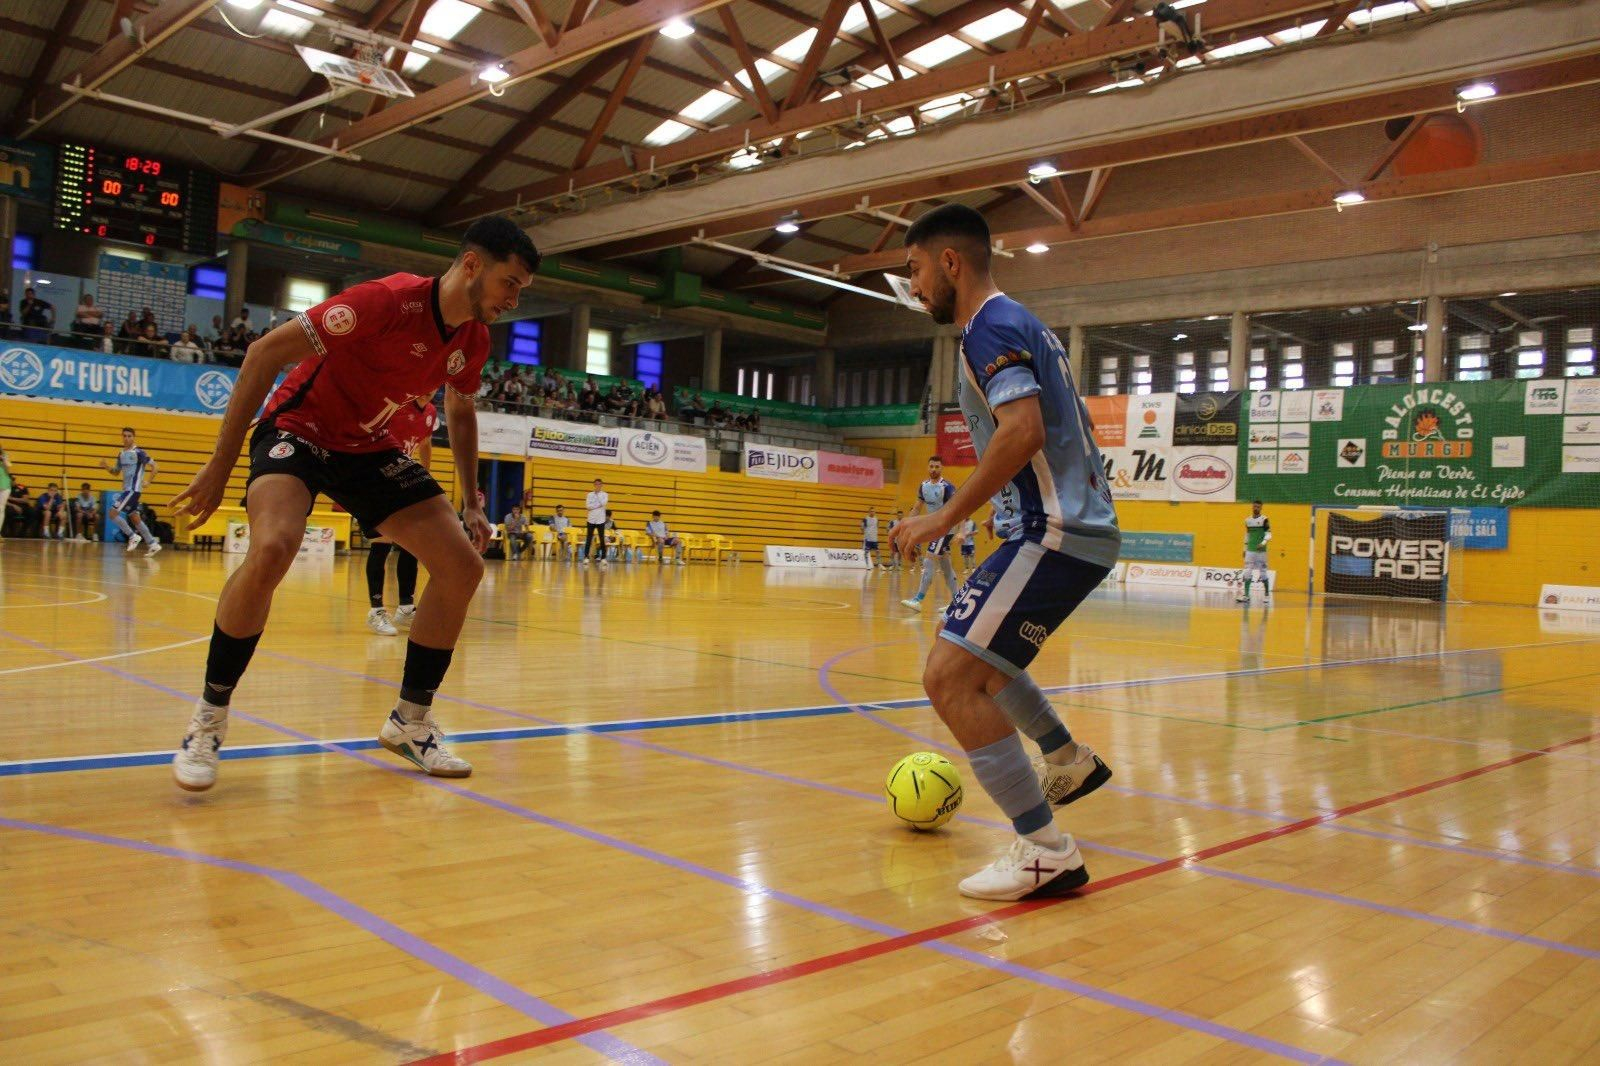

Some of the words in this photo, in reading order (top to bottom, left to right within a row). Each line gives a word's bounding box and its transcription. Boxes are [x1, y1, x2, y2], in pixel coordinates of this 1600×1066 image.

[125, 157, 161, 176] 18:29
[103, 180, 121, 195] 00
[161, 191, 179, 207] 00
[78, 362, 153, 398] FUTSAL
[1382, 388, 1474, 440] BALONCESTO
[1388, 442, 1466, 456] MURGI
[1376, 465, 1417, 482] Piensa
[1419, 470, 1432, 478] en
[1334, 483, 1383, 497] Consume
[1385, 484, 1452, 499] Hortalizas
[1455, 485, 1468, 498] de
[1471, 484, 1488, 498] El
[1491, 483, 1526, 503] Ejido
[1331, 536, 1443, 560] POWER
[1374, 558, 1441, 580] ADE
